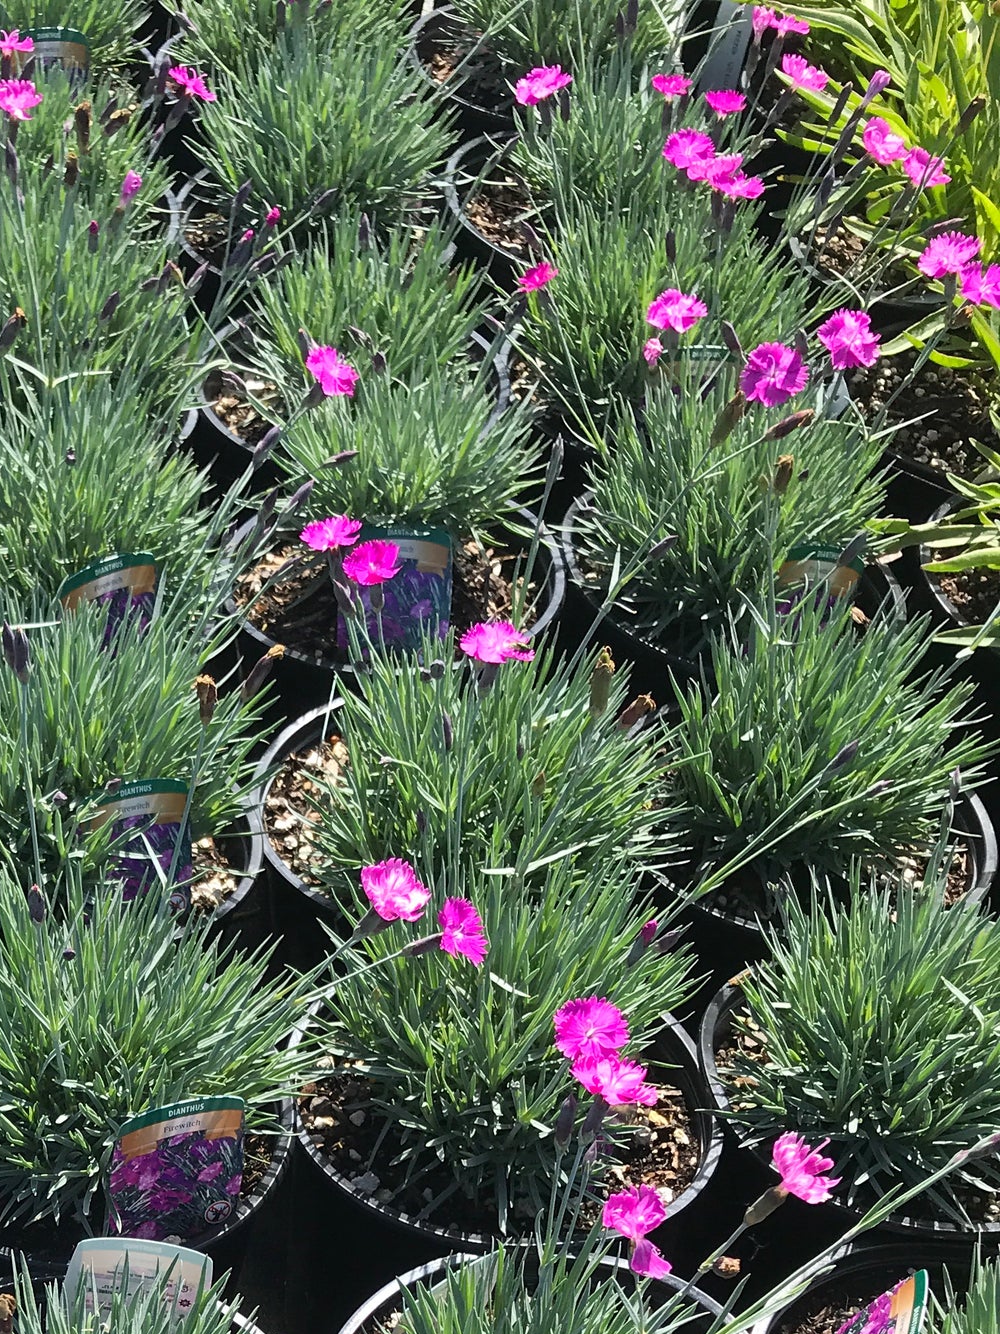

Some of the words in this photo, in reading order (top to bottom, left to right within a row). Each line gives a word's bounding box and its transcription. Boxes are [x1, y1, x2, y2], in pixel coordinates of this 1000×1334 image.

[120, 784, 152, 797] DIANTHUS
[168, 1102, 205, 1118] DIANTHUS
[163, 1119, 201, 1134] Firewitch
